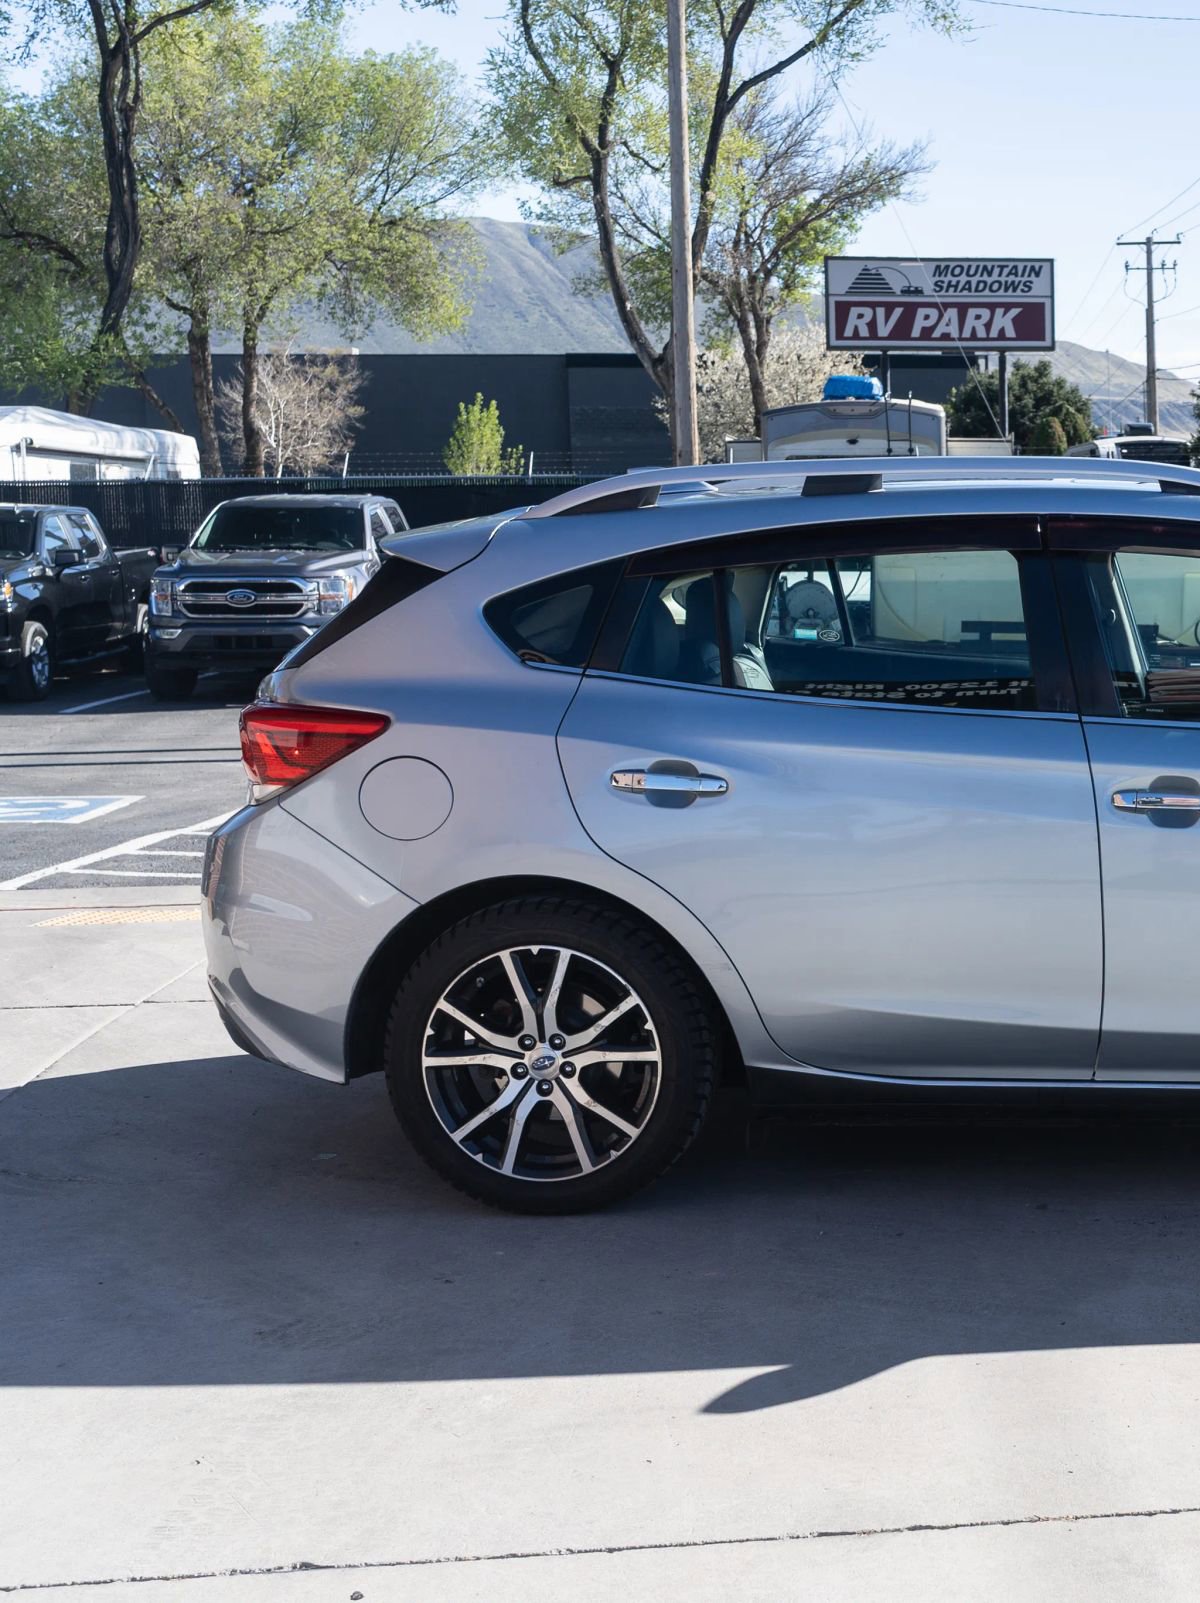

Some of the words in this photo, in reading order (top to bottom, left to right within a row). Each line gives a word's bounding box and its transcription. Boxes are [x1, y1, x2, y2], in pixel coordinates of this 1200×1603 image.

[932, 264, 1043, 278] MOUNTAIN
[933, 279, 1034, 294] SHADOWS
[843, 306, 904, 337] RV
[911, 307, 1023, 338] PARK
